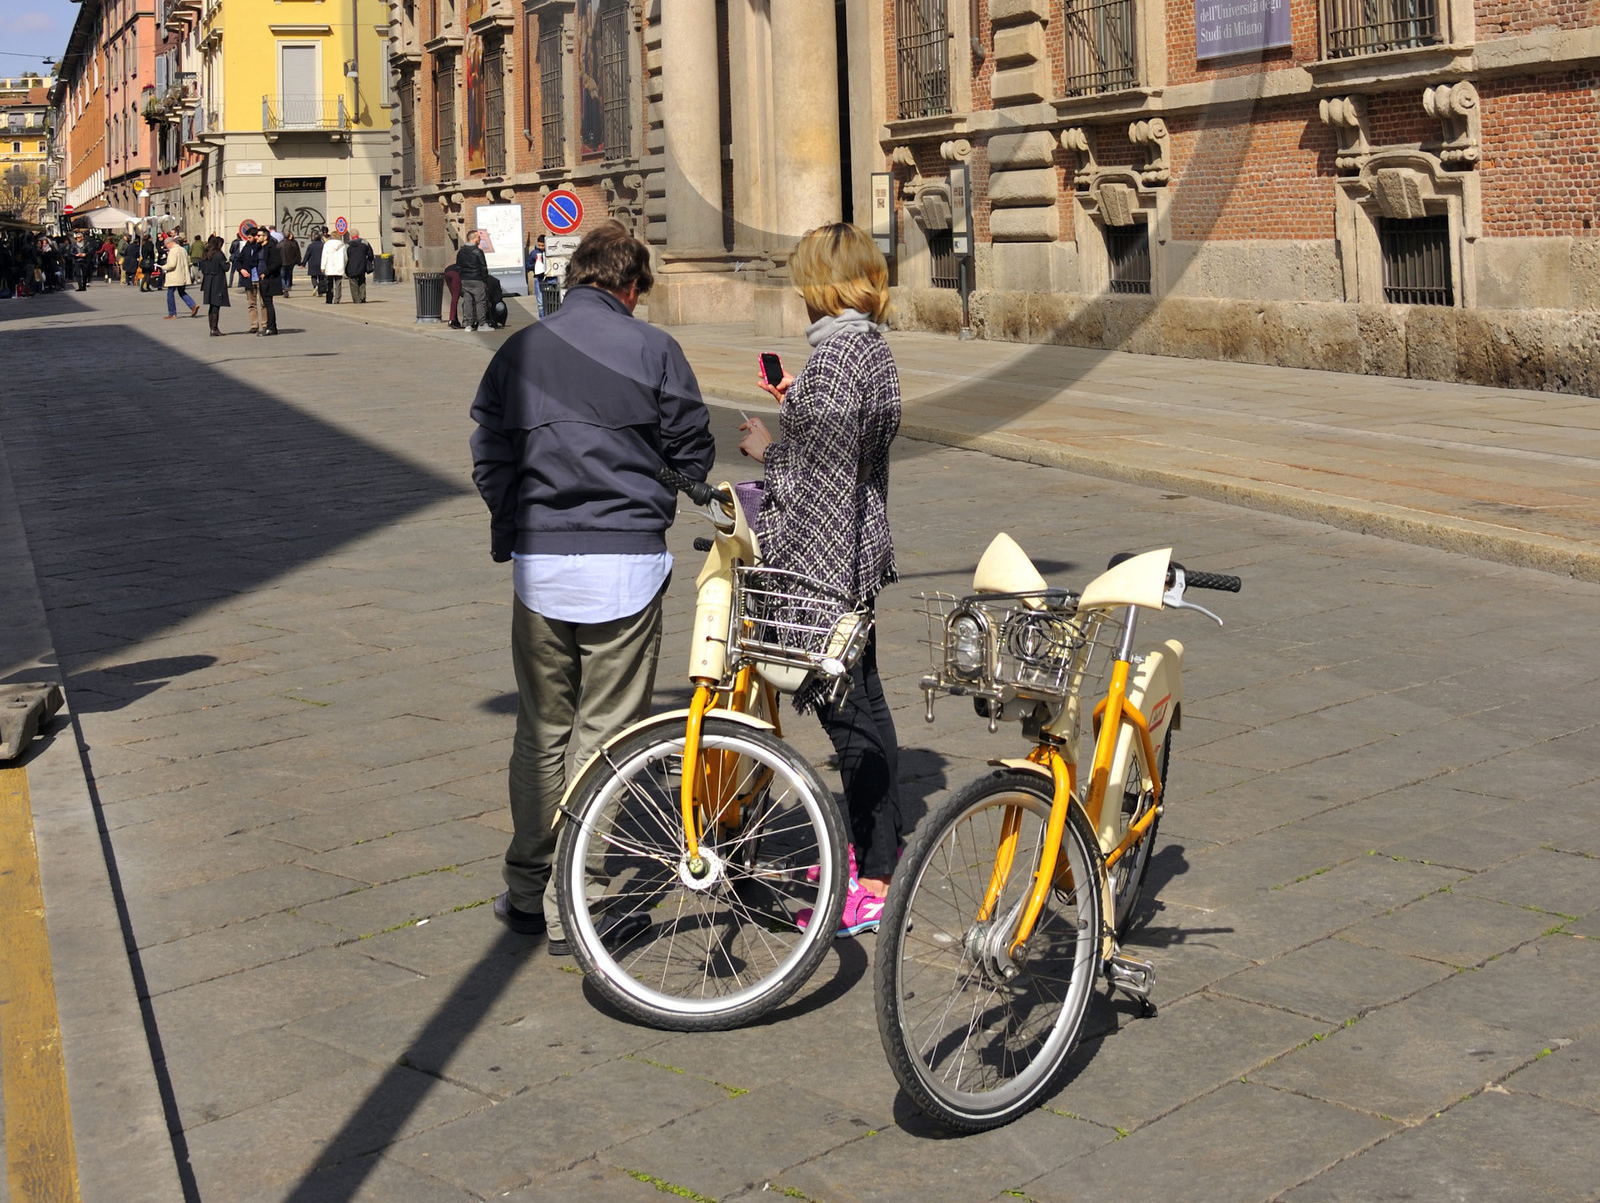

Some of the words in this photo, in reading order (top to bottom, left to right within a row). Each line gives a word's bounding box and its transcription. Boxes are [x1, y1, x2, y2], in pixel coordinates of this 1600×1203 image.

[1200, 0, 1259, 23] dell'Università
[1200, 25, 1222, 43] Studi
[1223, 24, 1232, 38] di
[1233, 20, 1263, 37] Milano
